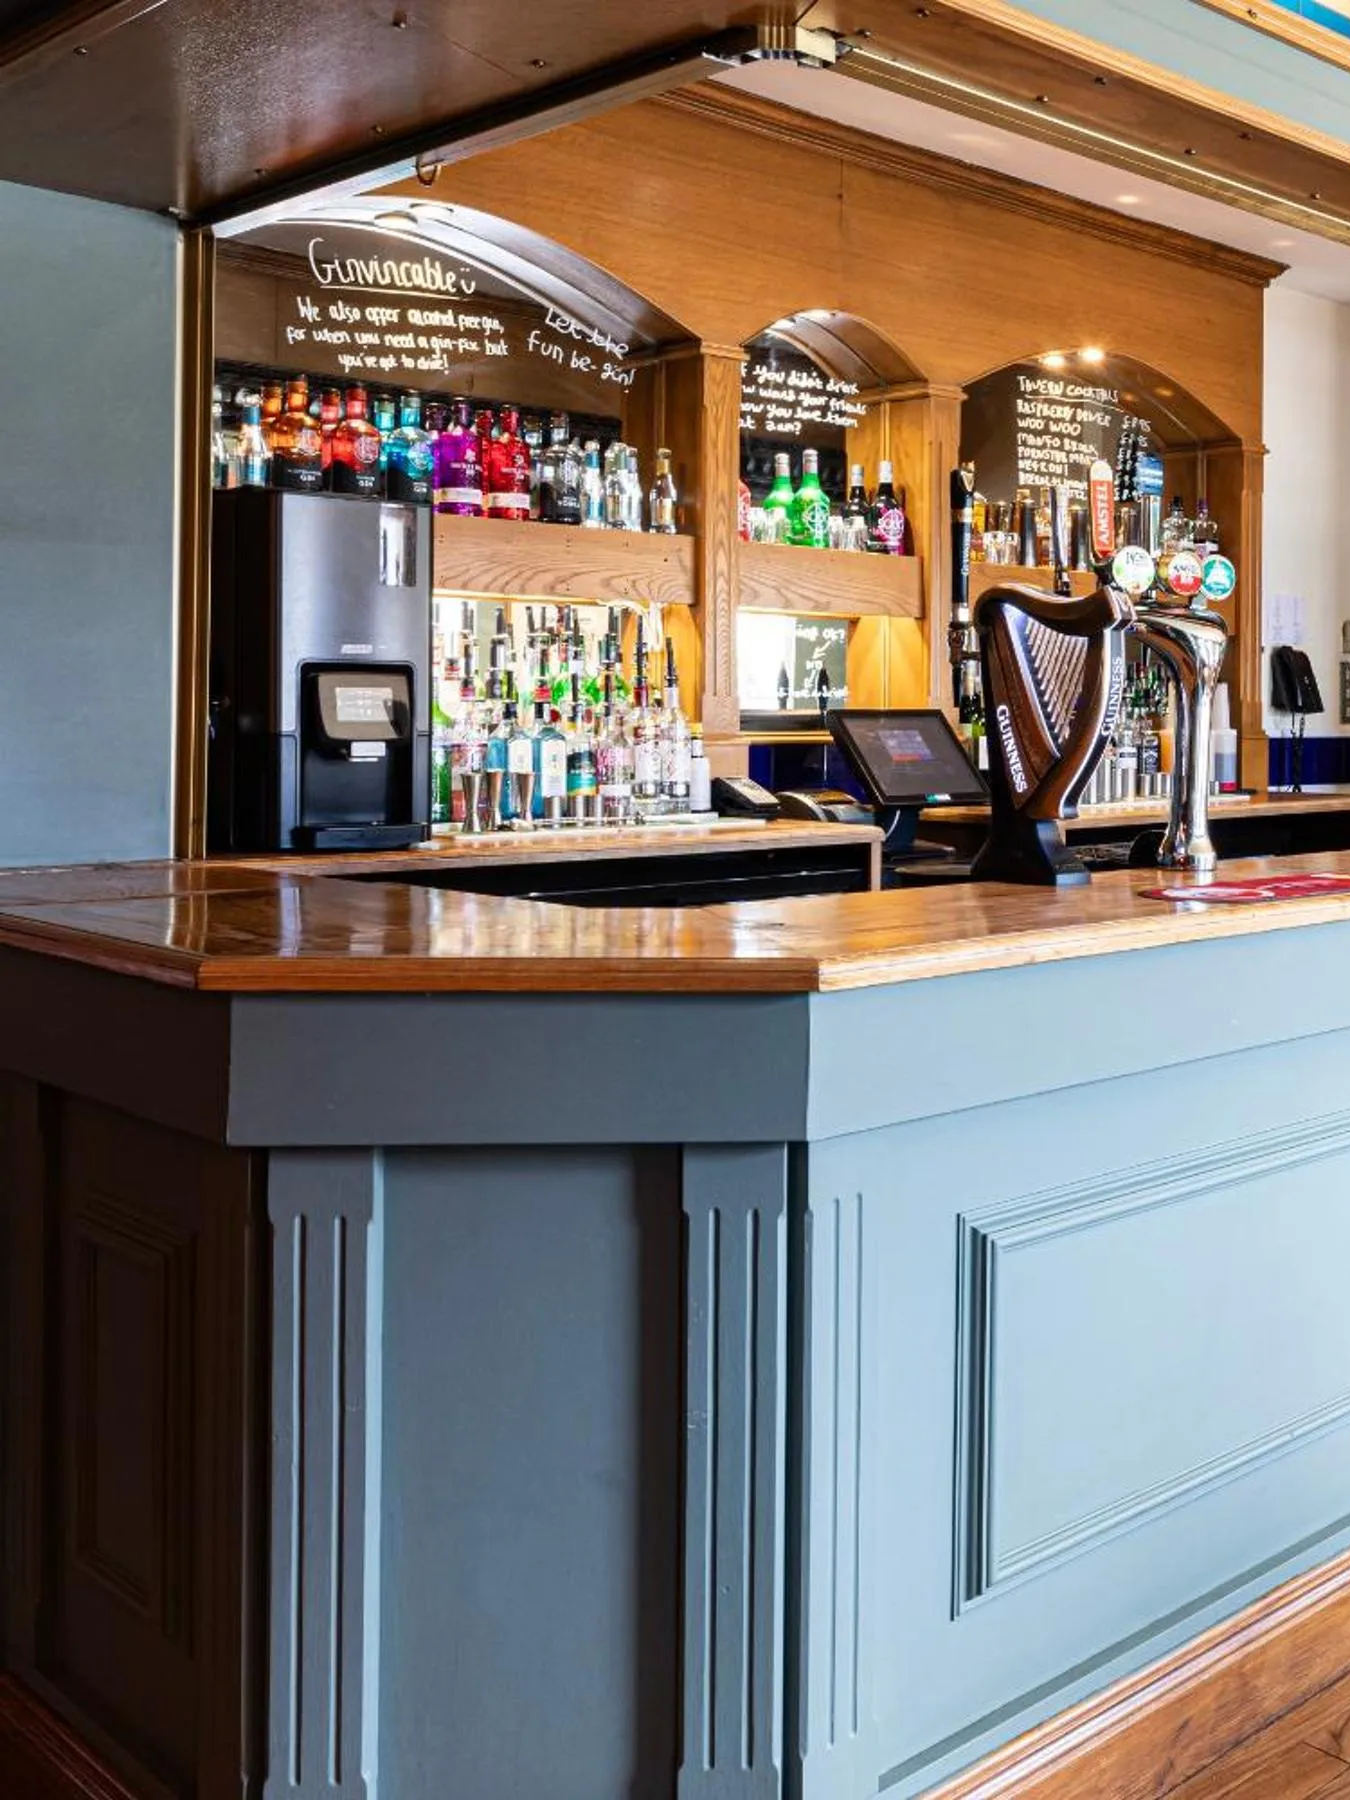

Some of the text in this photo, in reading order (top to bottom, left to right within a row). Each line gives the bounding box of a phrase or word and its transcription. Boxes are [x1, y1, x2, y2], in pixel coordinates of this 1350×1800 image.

[296, 296, 321, 323] We
[328, 299, 361, 324] also
[365, 306, 401, 326] offer
[286, 325, 307, 344] for
[312, 328, 351, 344] when
[384, 332, 416, 348] need
[417, 336, 429, 349] a
[484, 338, 508, 356] but
[379, 354, 398, 372] got
[401, 353, 415, 369] to
[752, 365, 785, 384] you
[1017, 375, 1065, 395] TAVERN
[766, 404, 793, 419] you
[1016, 399, 1076, 421] RASPBERRY
[1017, 417, 1047, 430] WOO
[1050, 421, 1081, 436] WOO
[1018, 459, 1069, 477] NEGRONI
[1095, 483, 1111, 545] AMSTEL
[1101, 656, 1123, 737] GUINNESS
[996, 703, 1030, 794] GUINNESS
